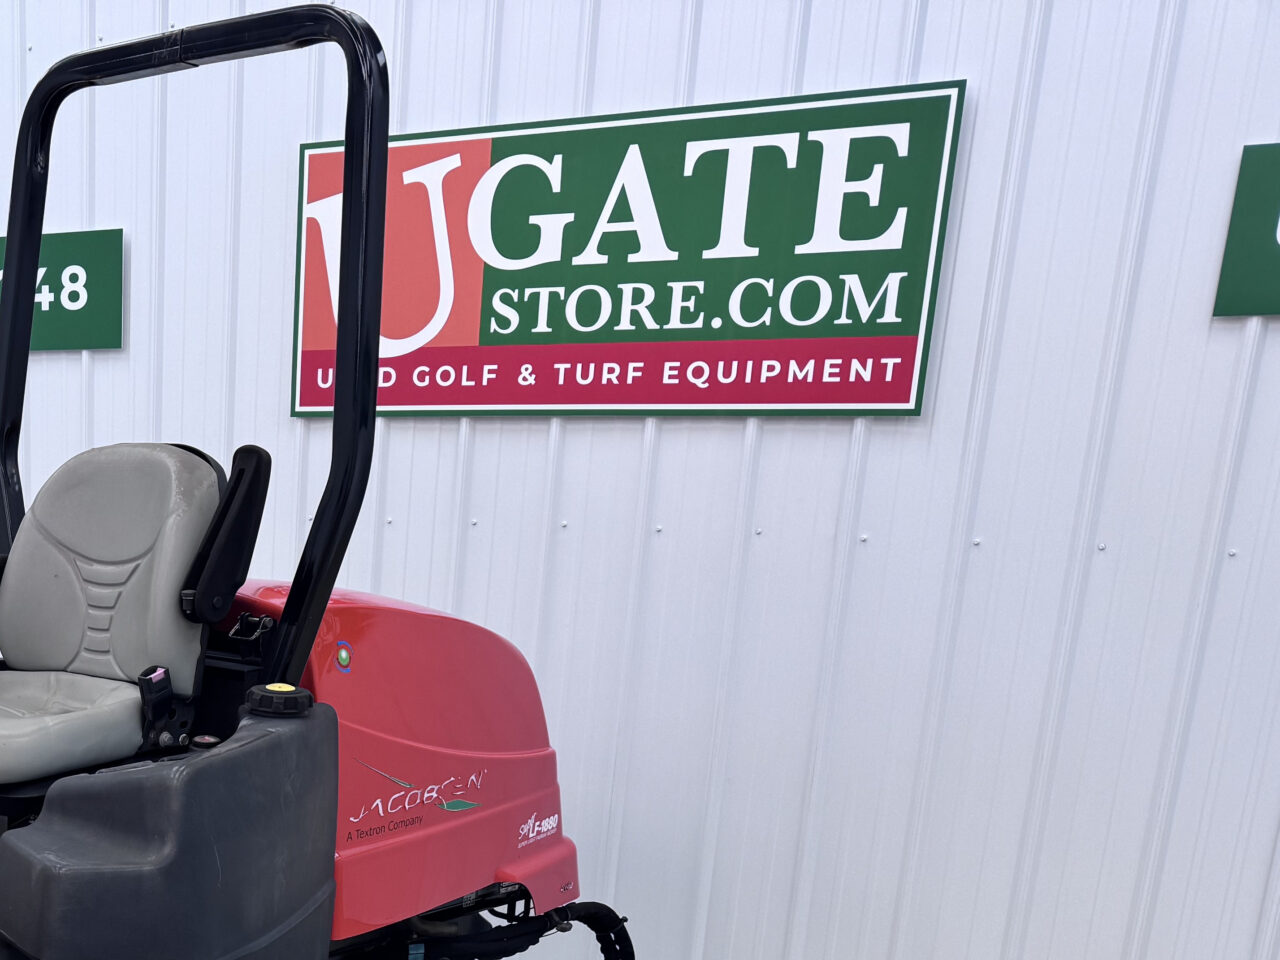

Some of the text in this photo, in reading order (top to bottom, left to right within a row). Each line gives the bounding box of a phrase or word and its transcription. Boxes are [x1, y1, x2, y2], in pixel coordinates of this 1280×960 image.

[490, 271, 908, 334] STORE.COM
[317, 357, 902, 389] UD GOLF & TURF EQUIPMENT
[346, 815, 424, 843] A Textron Company
